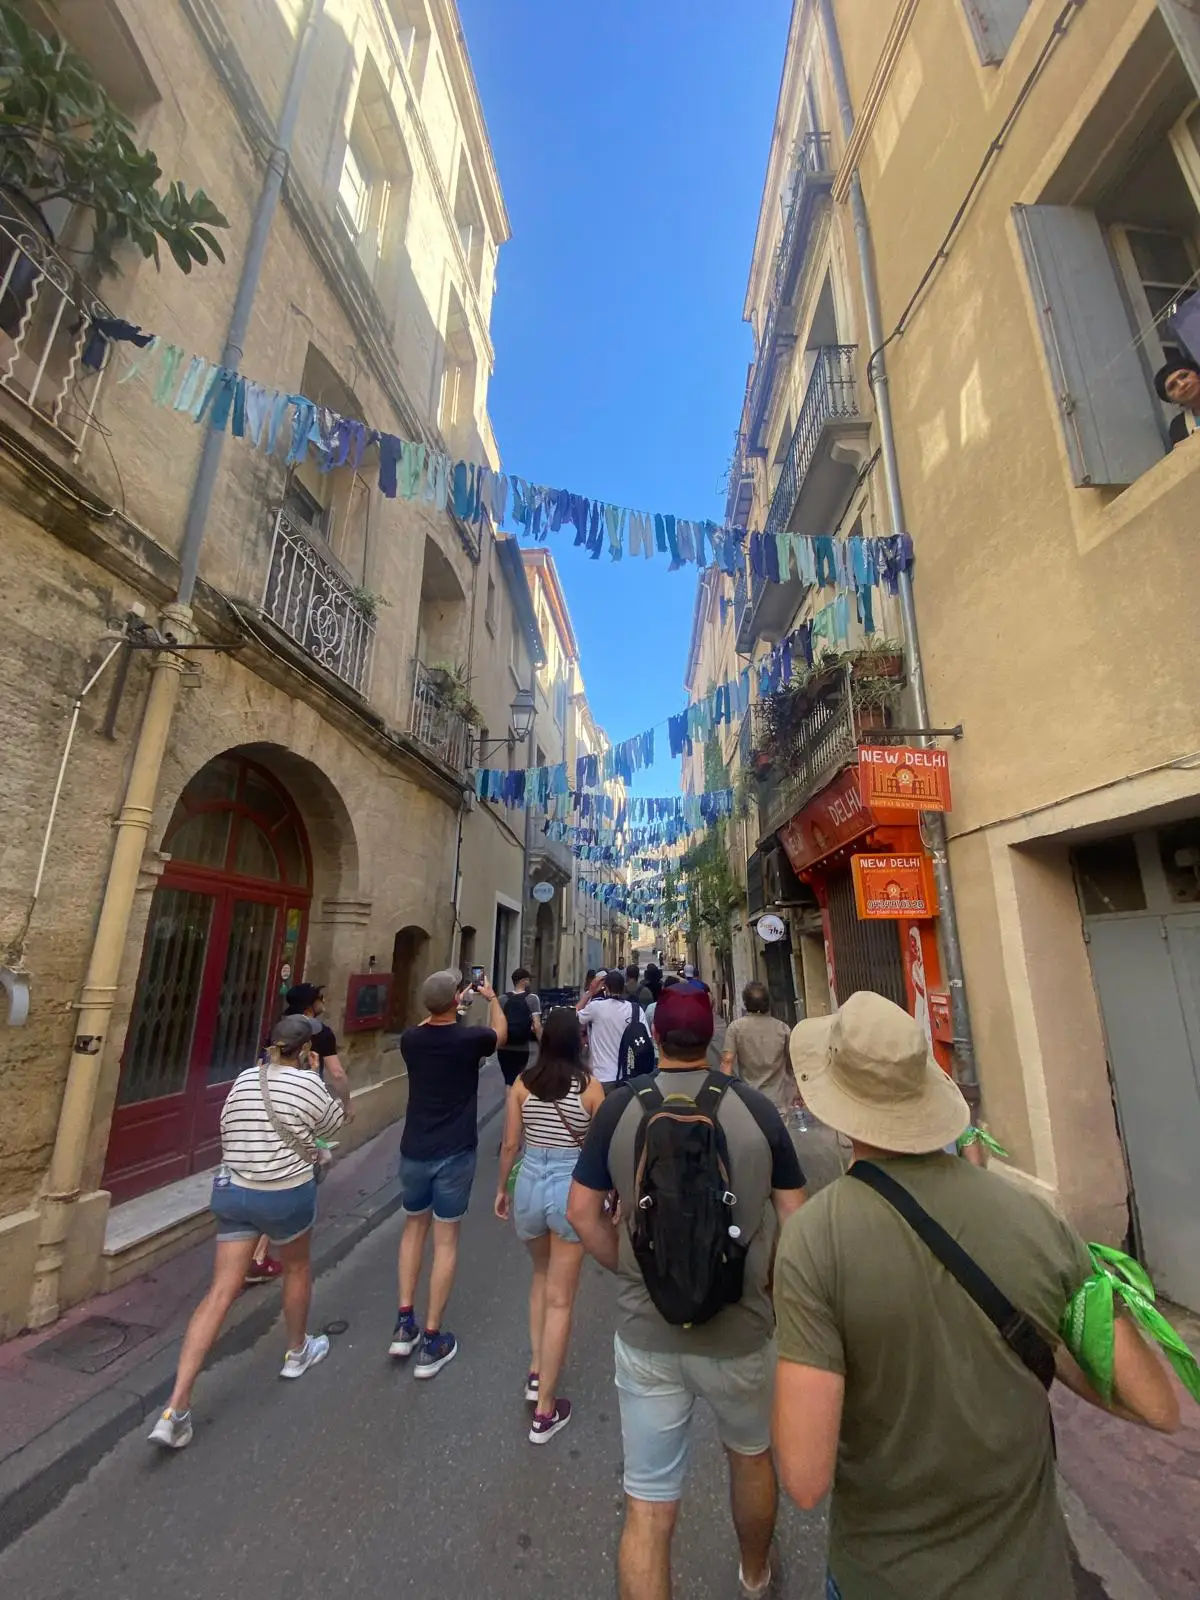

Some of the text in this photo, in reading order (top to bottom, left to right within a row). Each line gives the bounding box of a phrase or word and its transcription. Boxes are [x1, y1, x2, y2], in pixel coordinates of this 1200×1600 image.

[861, 750, 946, 767] NEW DELHI
[827, 786, 863, 828] DELHI
[860, 858, 920, 868] NEW DELHI
